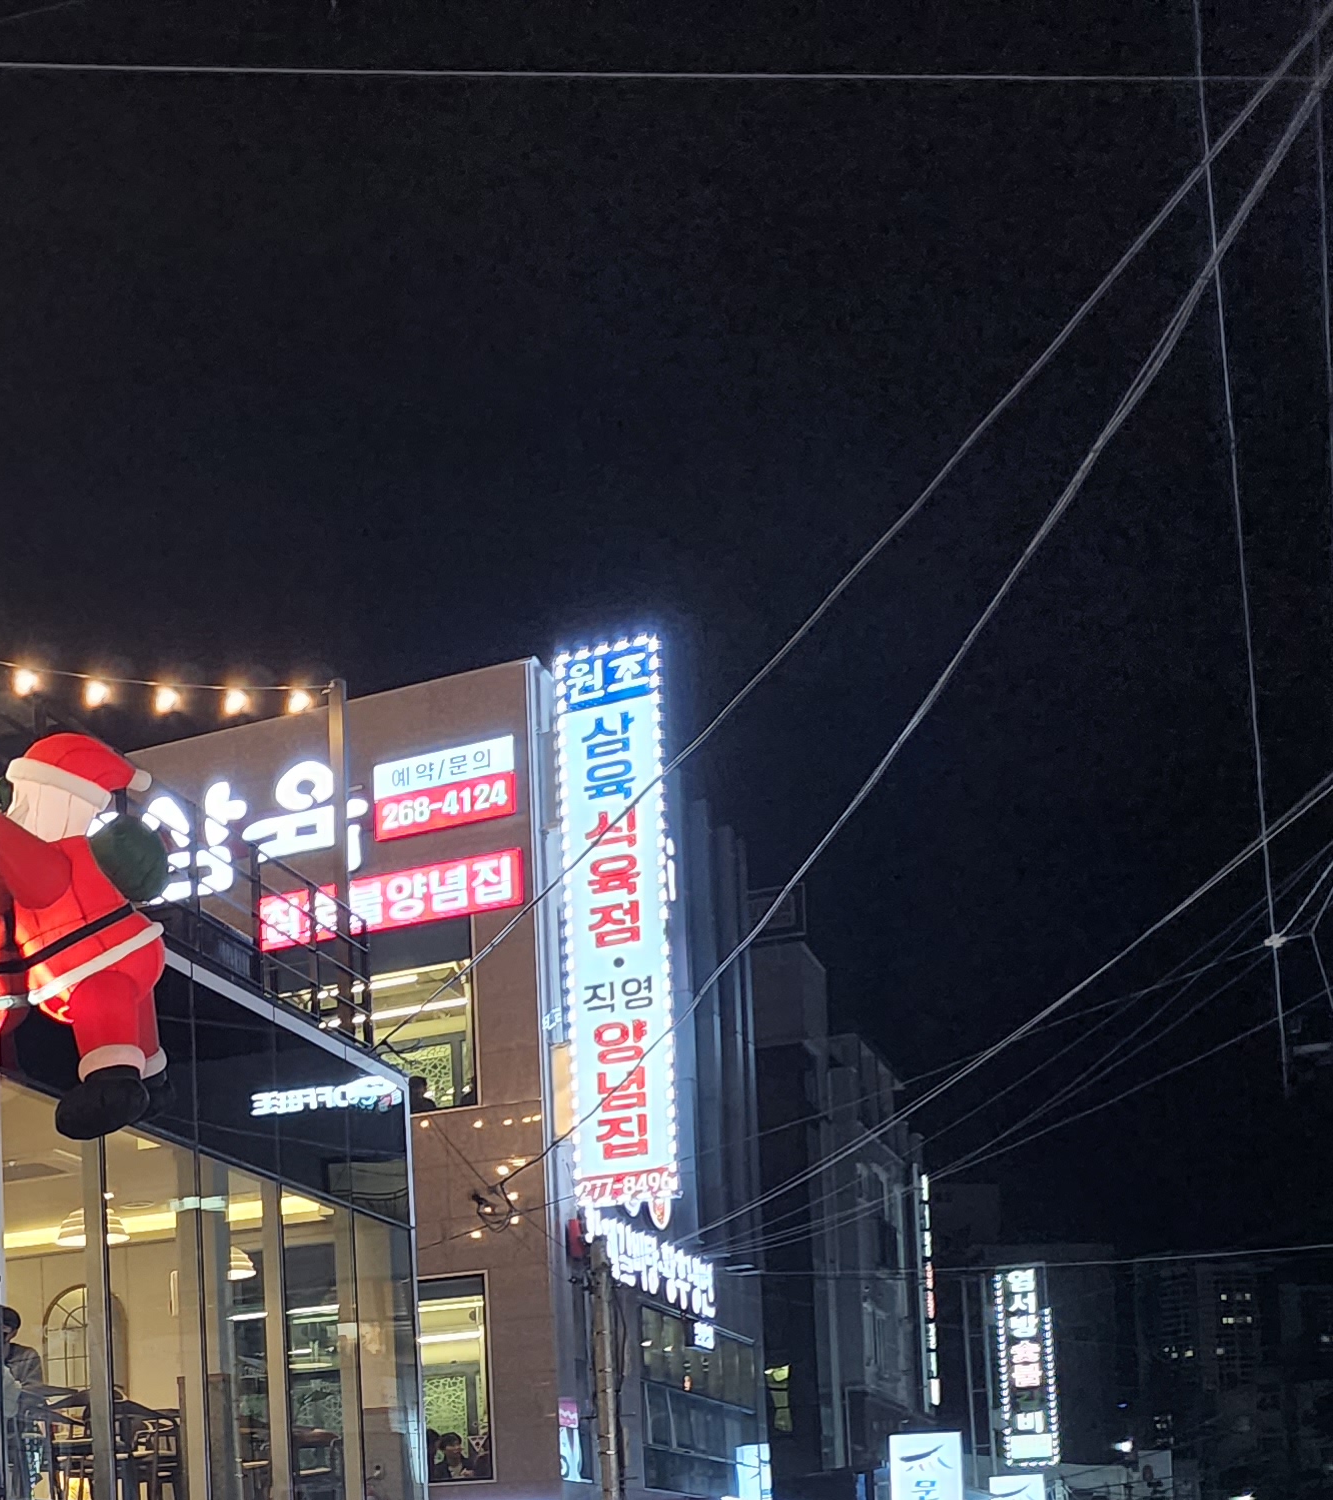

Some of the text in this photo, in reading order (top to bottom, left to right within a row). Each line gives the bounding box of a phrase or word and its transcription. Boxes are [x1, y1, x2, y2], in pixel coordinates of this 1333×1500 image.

[565, 652, 651, 703] 원조
[391, 749, 491, 788] 예약/문의
[382, 779, 508, 831] 268-4124
[581, 711, 642, 949] 삼육 식육점
[583, 975, 653, 1013] 직영
[593, 1018, 649, 1161] 양념집
[582, 1171, 671, 1200] 277-8496
